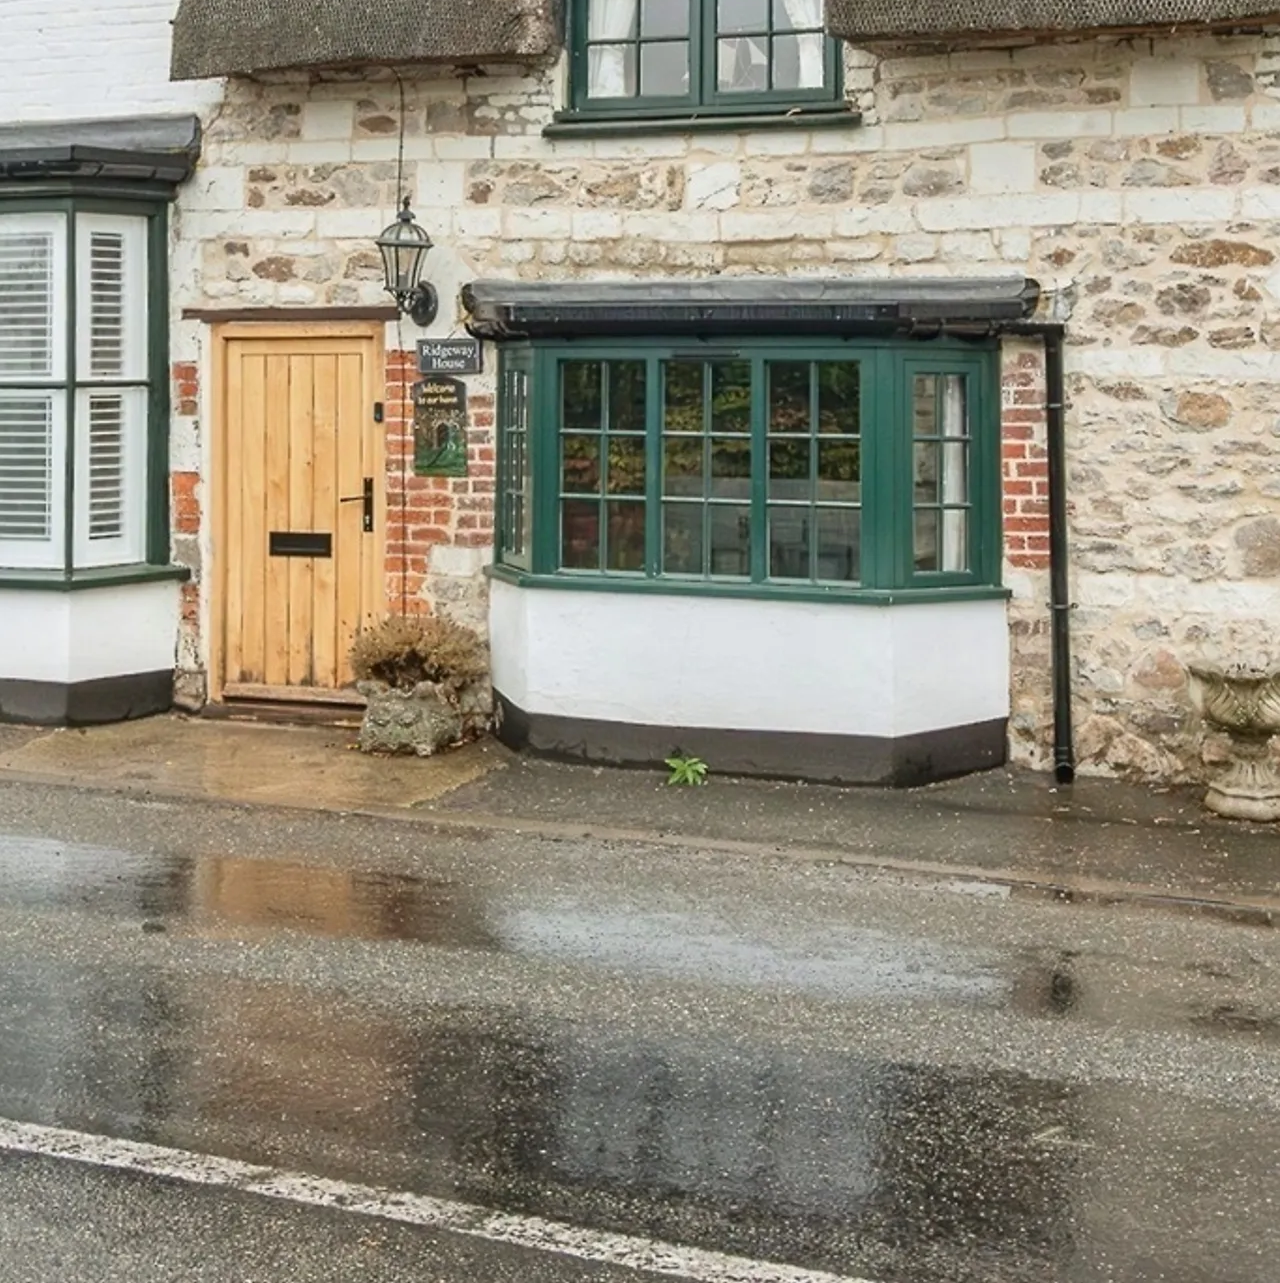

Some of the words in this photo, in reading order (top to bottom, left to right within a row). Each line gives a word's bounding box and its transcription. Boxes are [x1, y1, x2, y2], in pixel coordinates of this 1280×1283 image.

[422, 343, 475, 359] Ridgeway
[431, 357, 465, 370] House
[420, 382, 456, 394] Welcome
[418, 397, 426, 405] to
[427, 397, 438, 405] our
